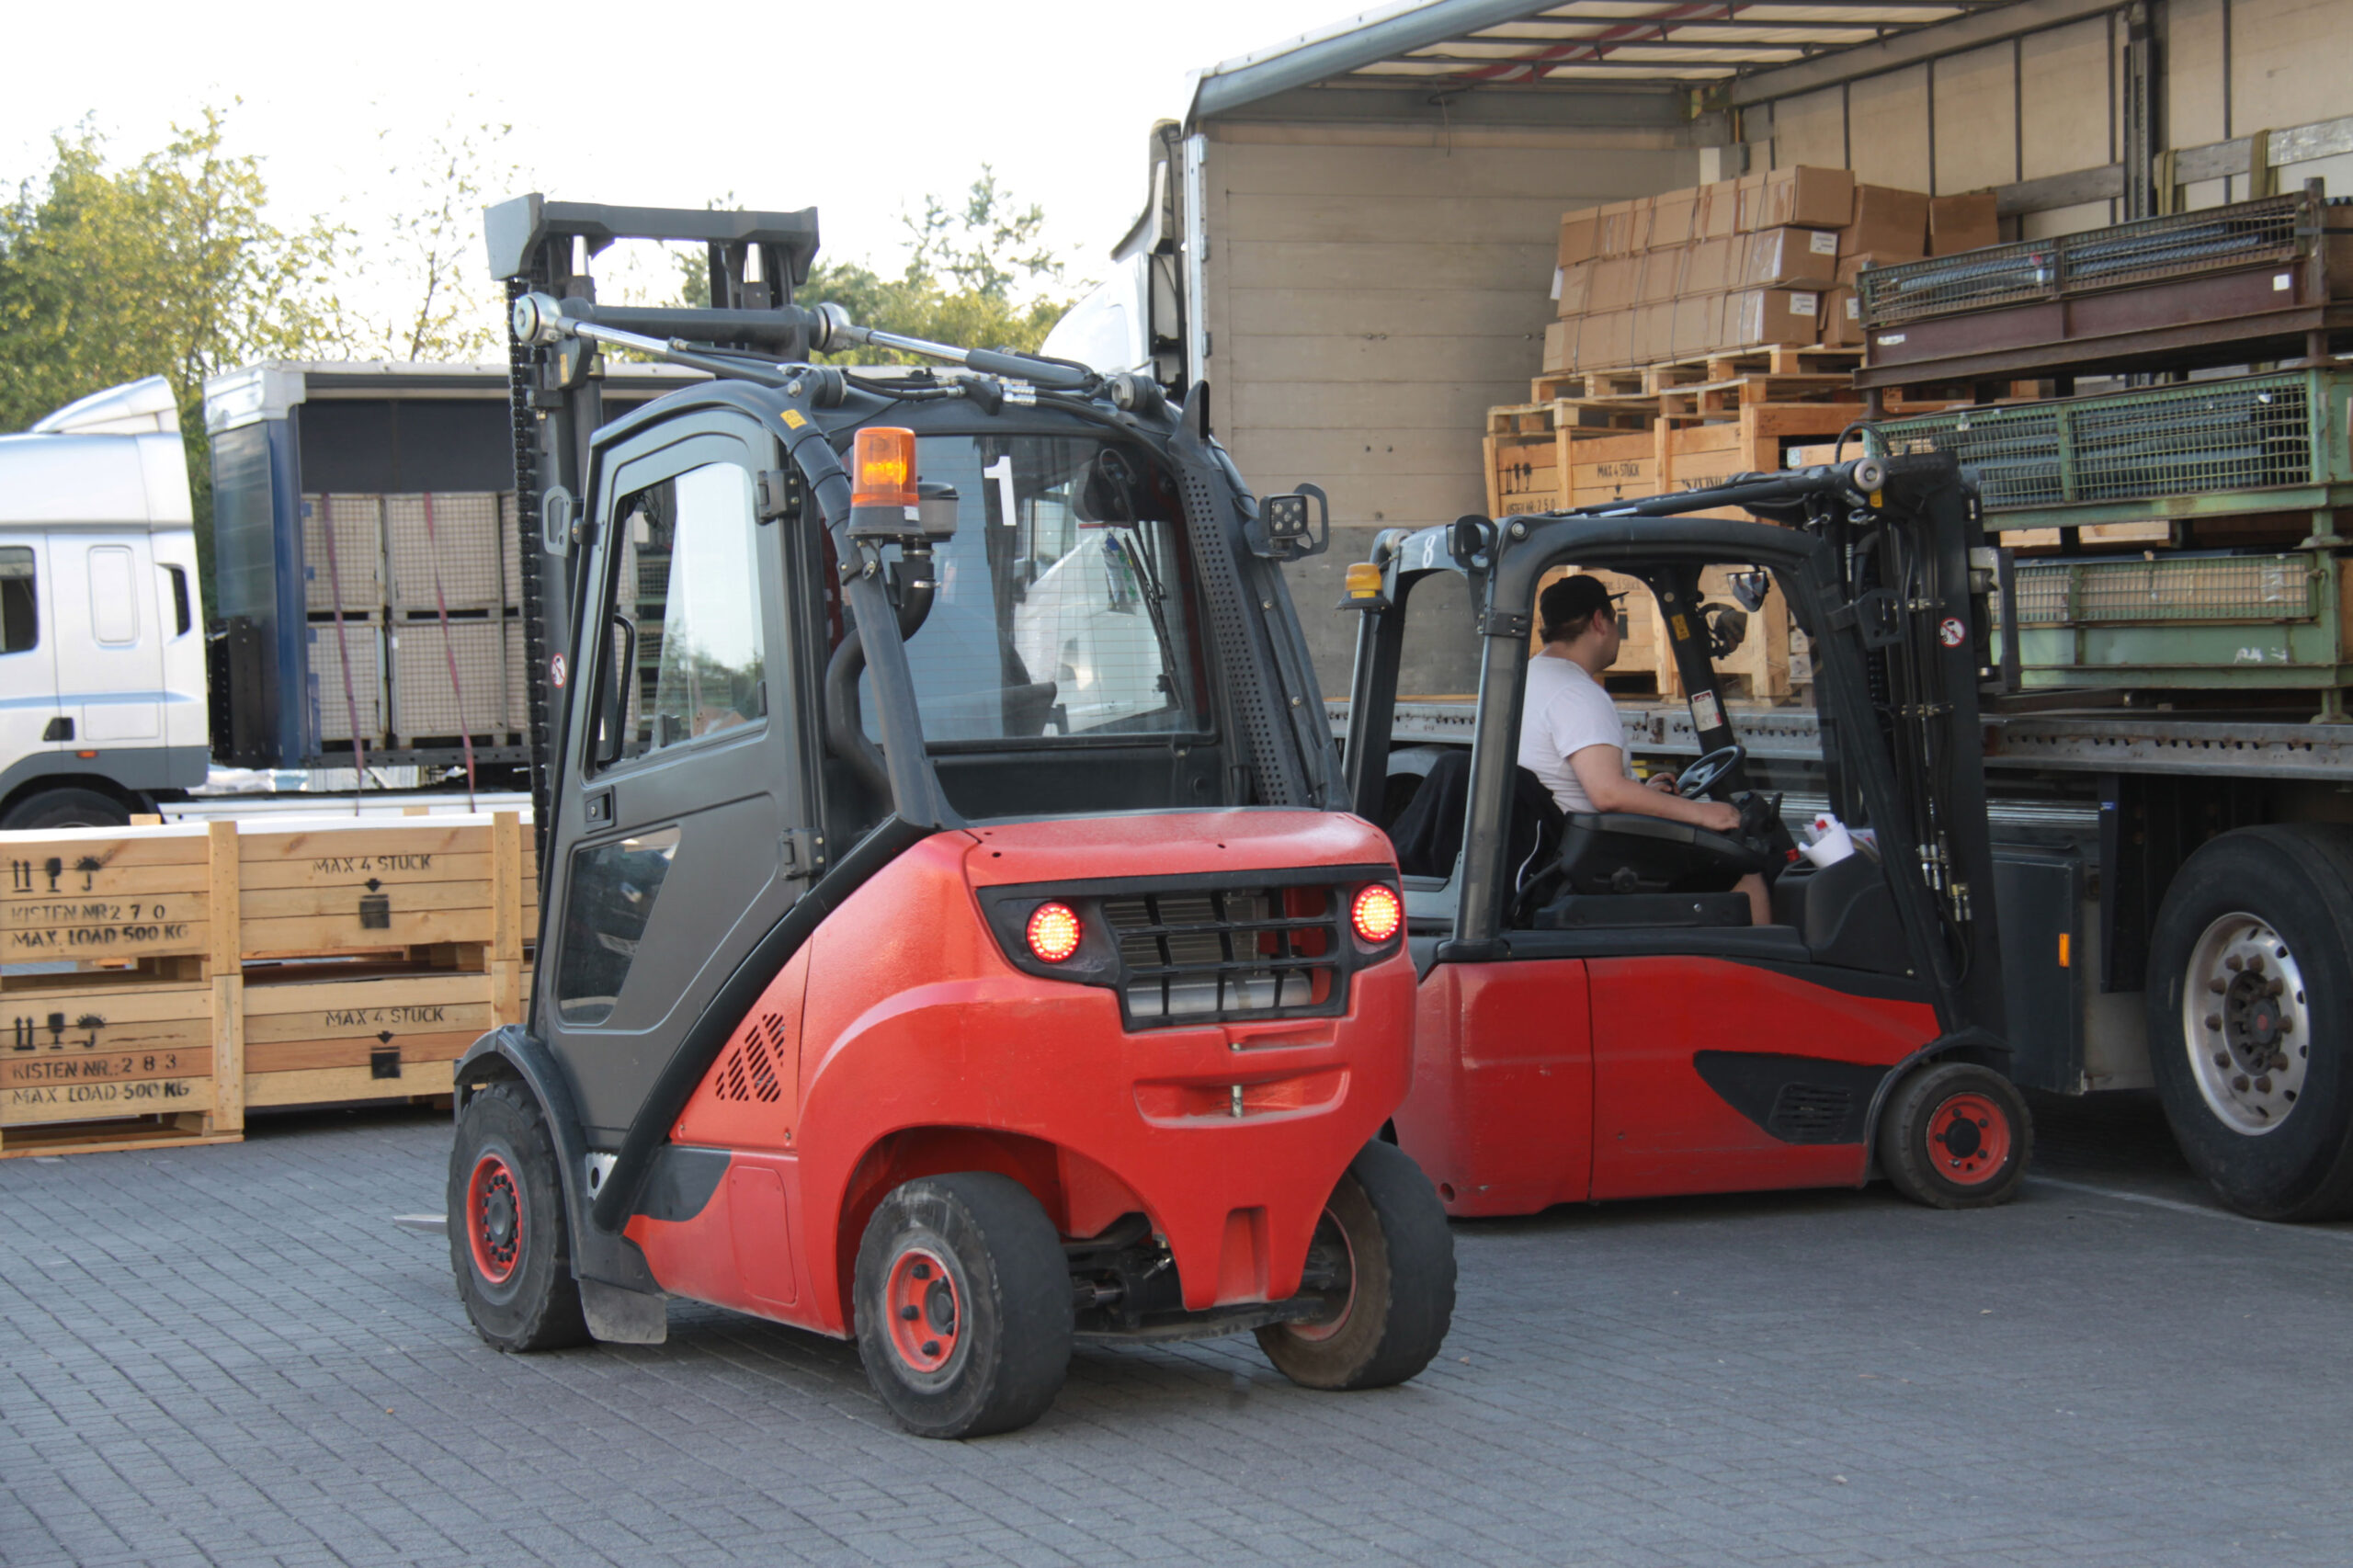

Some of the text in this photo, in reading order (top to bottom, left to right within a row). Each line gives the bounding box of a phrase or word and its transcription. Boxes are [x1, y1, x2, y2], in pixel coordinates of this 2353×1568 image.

[983, 456, 1017, 526] 1
[1423, 534, 1437, 568] 8
[313, 857, 354, 874] MAX
[360, 857, 371, 870] 4
[12, 904, 77, 923] KISTEN
[68, 927, 116, 946] LOAD
[123, 926, 159, 943] 500
[164, 924, 188, 940] KG
[325, 1010, 367, 1026] MAX
[373, 1010, 383, 1023] 4
[13, 1061, 77, 1080] KISTEN
[13, 1081, 189, 1105] MAX LOAD 500 KG
